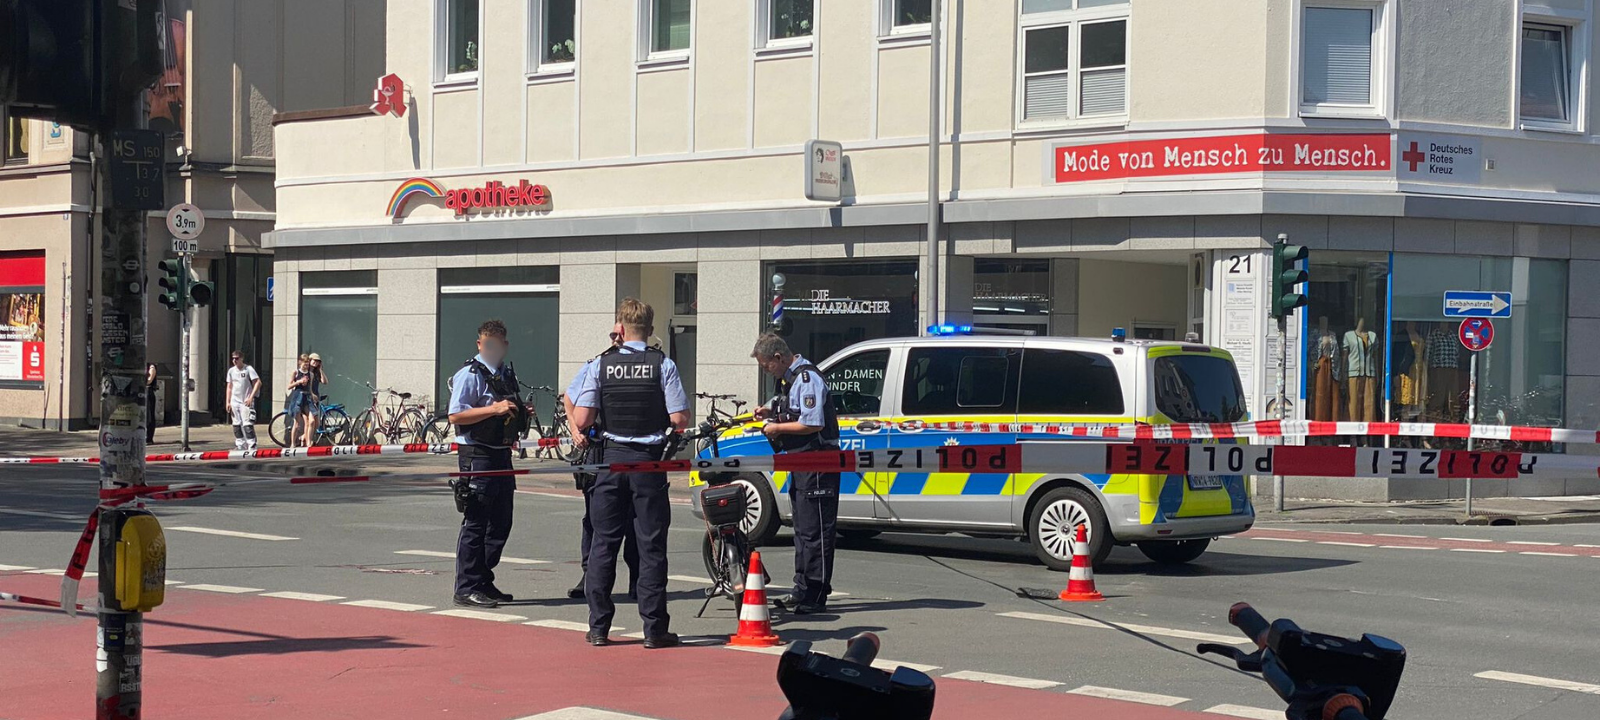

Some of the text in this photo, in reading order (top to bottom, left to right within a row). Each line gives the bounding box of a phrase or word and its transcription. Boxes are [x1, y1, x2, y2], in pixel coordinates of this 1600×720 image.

[113, 139, 160, 158] MS 150
[1430, 143, 1473, 155] Deutsches
[1063, 143, 1386, 172] Mode von Mensch zu Mensch.
[1430, 154, 1454, 164] Rotes
[1429, 164, 1453, 174] Kreuz
[445, 179, 546, 214] apotheke
[174, 240, 197, 251] 100 m
[1229, 255, 1251, 274] 21
[811, 290, 829, 301] DIE
[811, 301, 891, 314] HAARMACHER
[1449, 300, 1494, 308] Einbahnstraße
[606, 364, 653, 380] POLIZEI
[844, 368, 883, 380] DAMEN
[828, 381, 861, 392] INDER
[242, 448, 297, 458] POLIZEI
[325, 445, 376, 456] POLIZEI
[403, 443, 451, 454] POLIZEI
[840, 447, 1006, 470] POLIZEI
[1106, 446, 1273, 472] POLIZEI
[1372, 450, 1537, 474] POLIZEI
